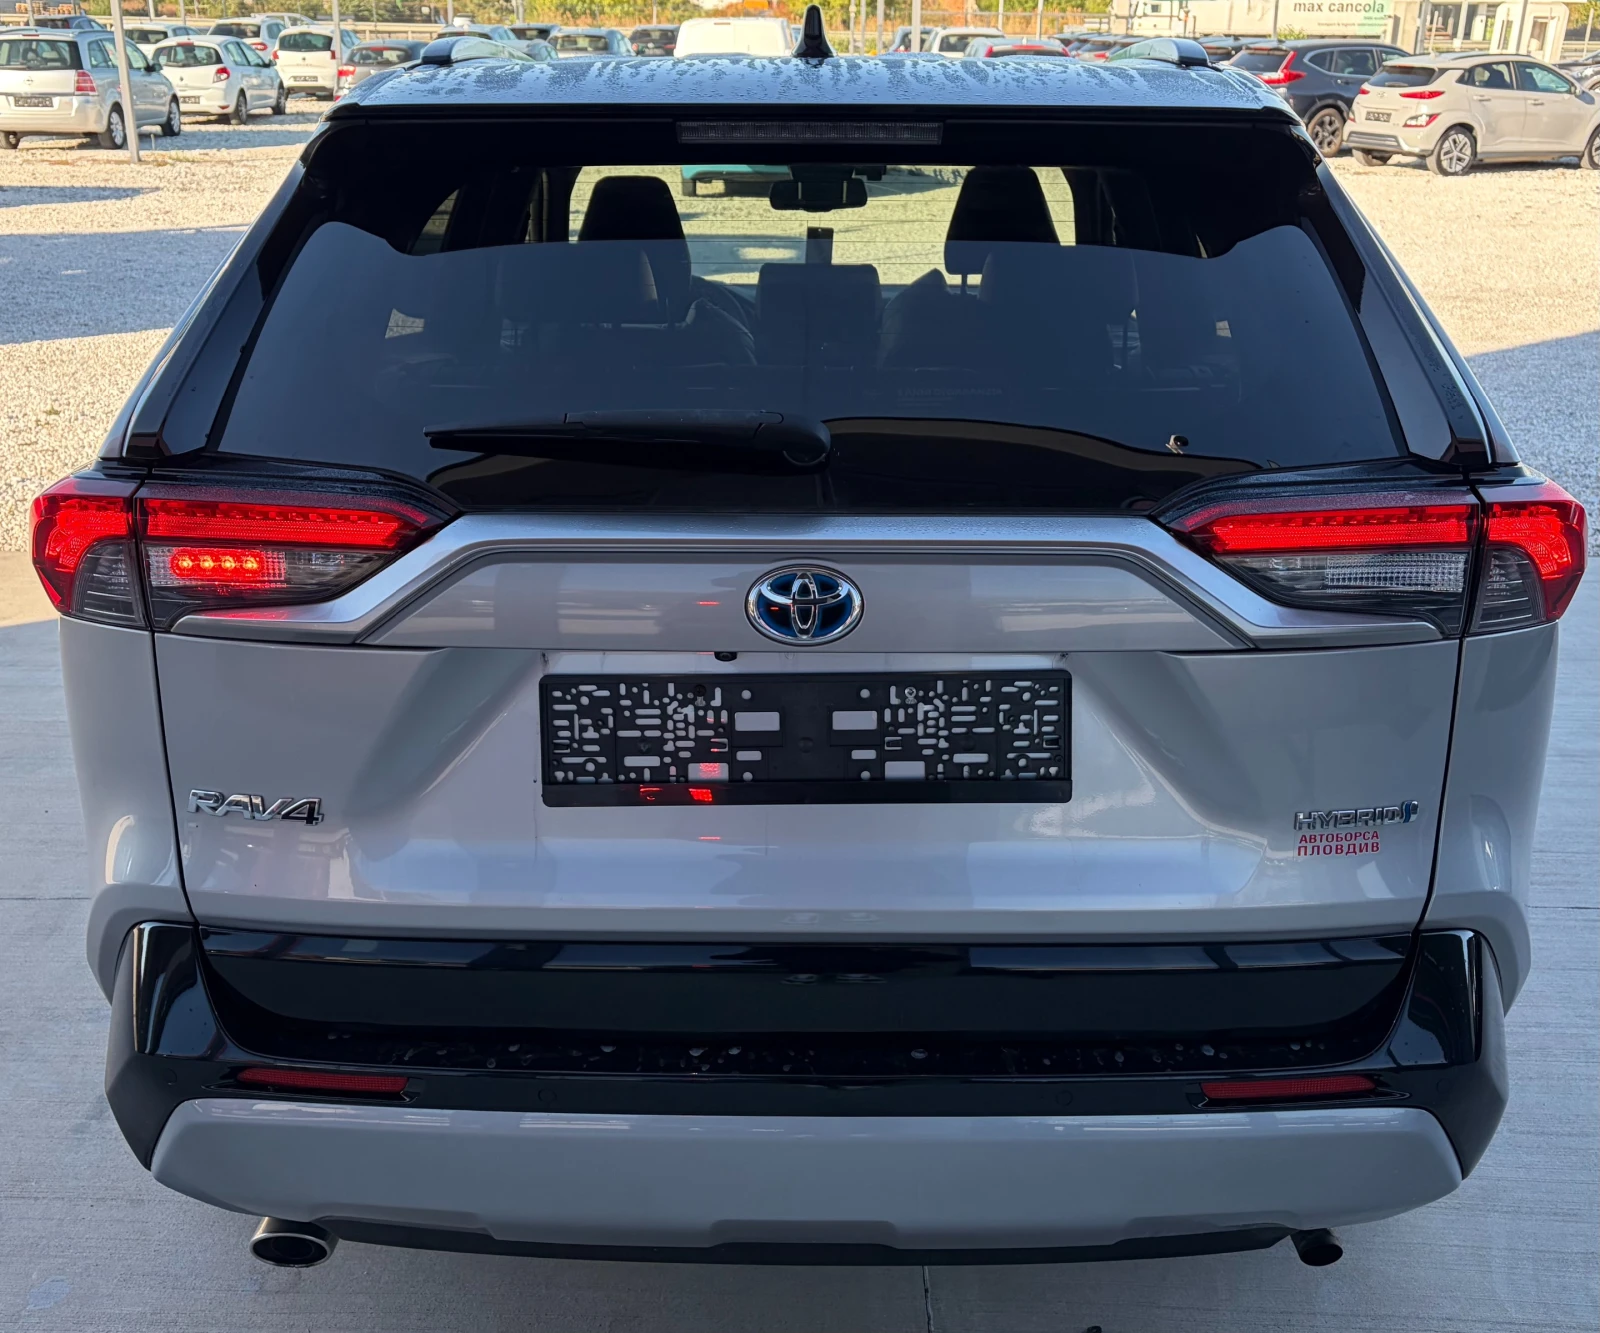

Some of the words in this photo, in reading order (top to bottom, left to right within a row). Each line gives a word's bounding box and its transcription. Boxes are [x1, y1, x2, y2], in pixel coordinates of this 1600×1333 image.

[1293, 2, 1323, 12] max
[1328, 0, 1385, 13] cancola
[187, 788, 324, 826] RAV4
[1294, 806, 1401, 831] HYBRID
[1299, 831, 1380, 843] АВТОБОРСА
[1297, 842, 1380, 857] ПЛОВДИВ
